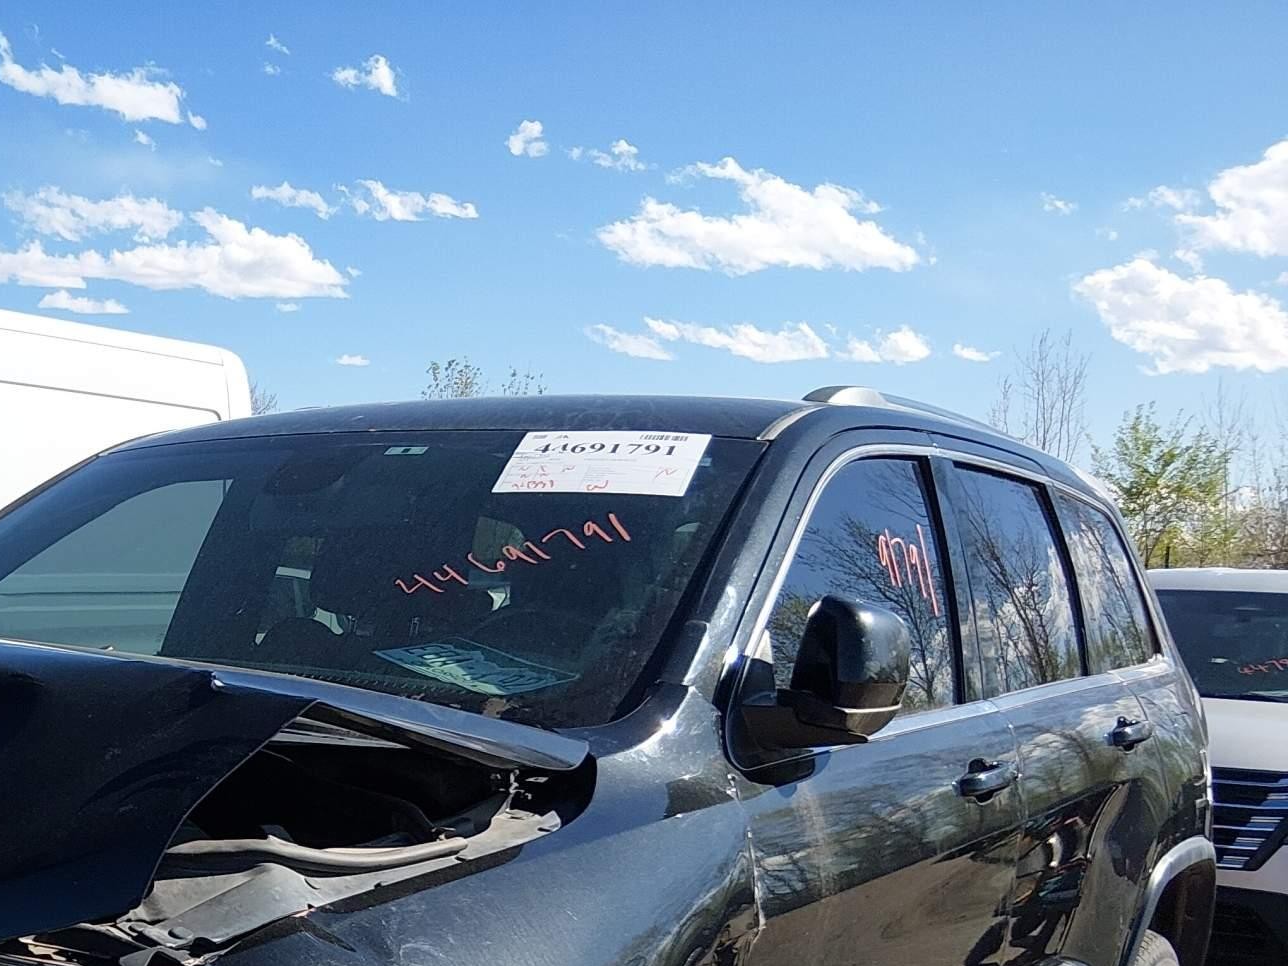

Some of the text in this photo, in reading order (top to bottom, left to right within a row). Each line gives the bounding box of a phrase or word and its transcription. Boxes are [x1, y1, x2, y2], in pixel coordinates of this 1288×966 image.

[534, 442, 677, 457] 44691791
[395, 513, 631, 593] 44691791
[878, 524, 939, 617] 9791
